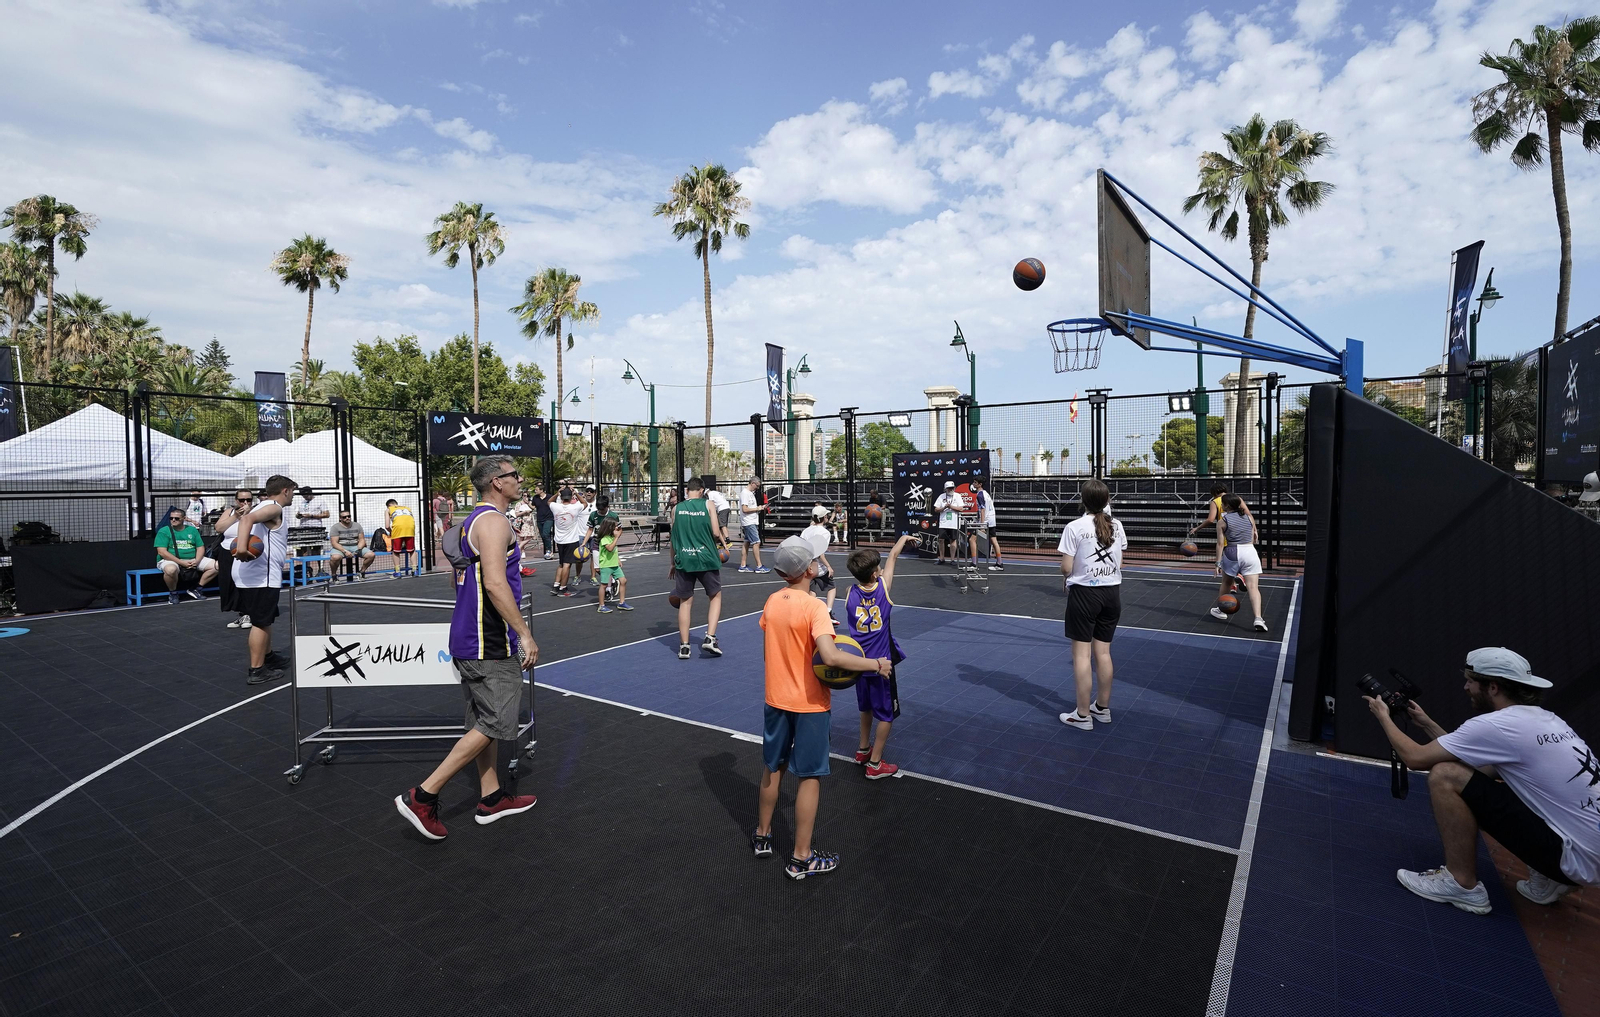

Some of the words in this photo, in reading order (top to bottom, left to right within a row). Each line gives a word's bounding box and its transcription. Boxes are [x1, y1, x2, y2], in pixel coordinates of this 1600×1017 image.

[489, 425, 522, 440] JAULA
[1093, 566, 1116, 577] JAULA
[856, 606, 883, 633] 23
[371, 643, 426, 665] JAULA
